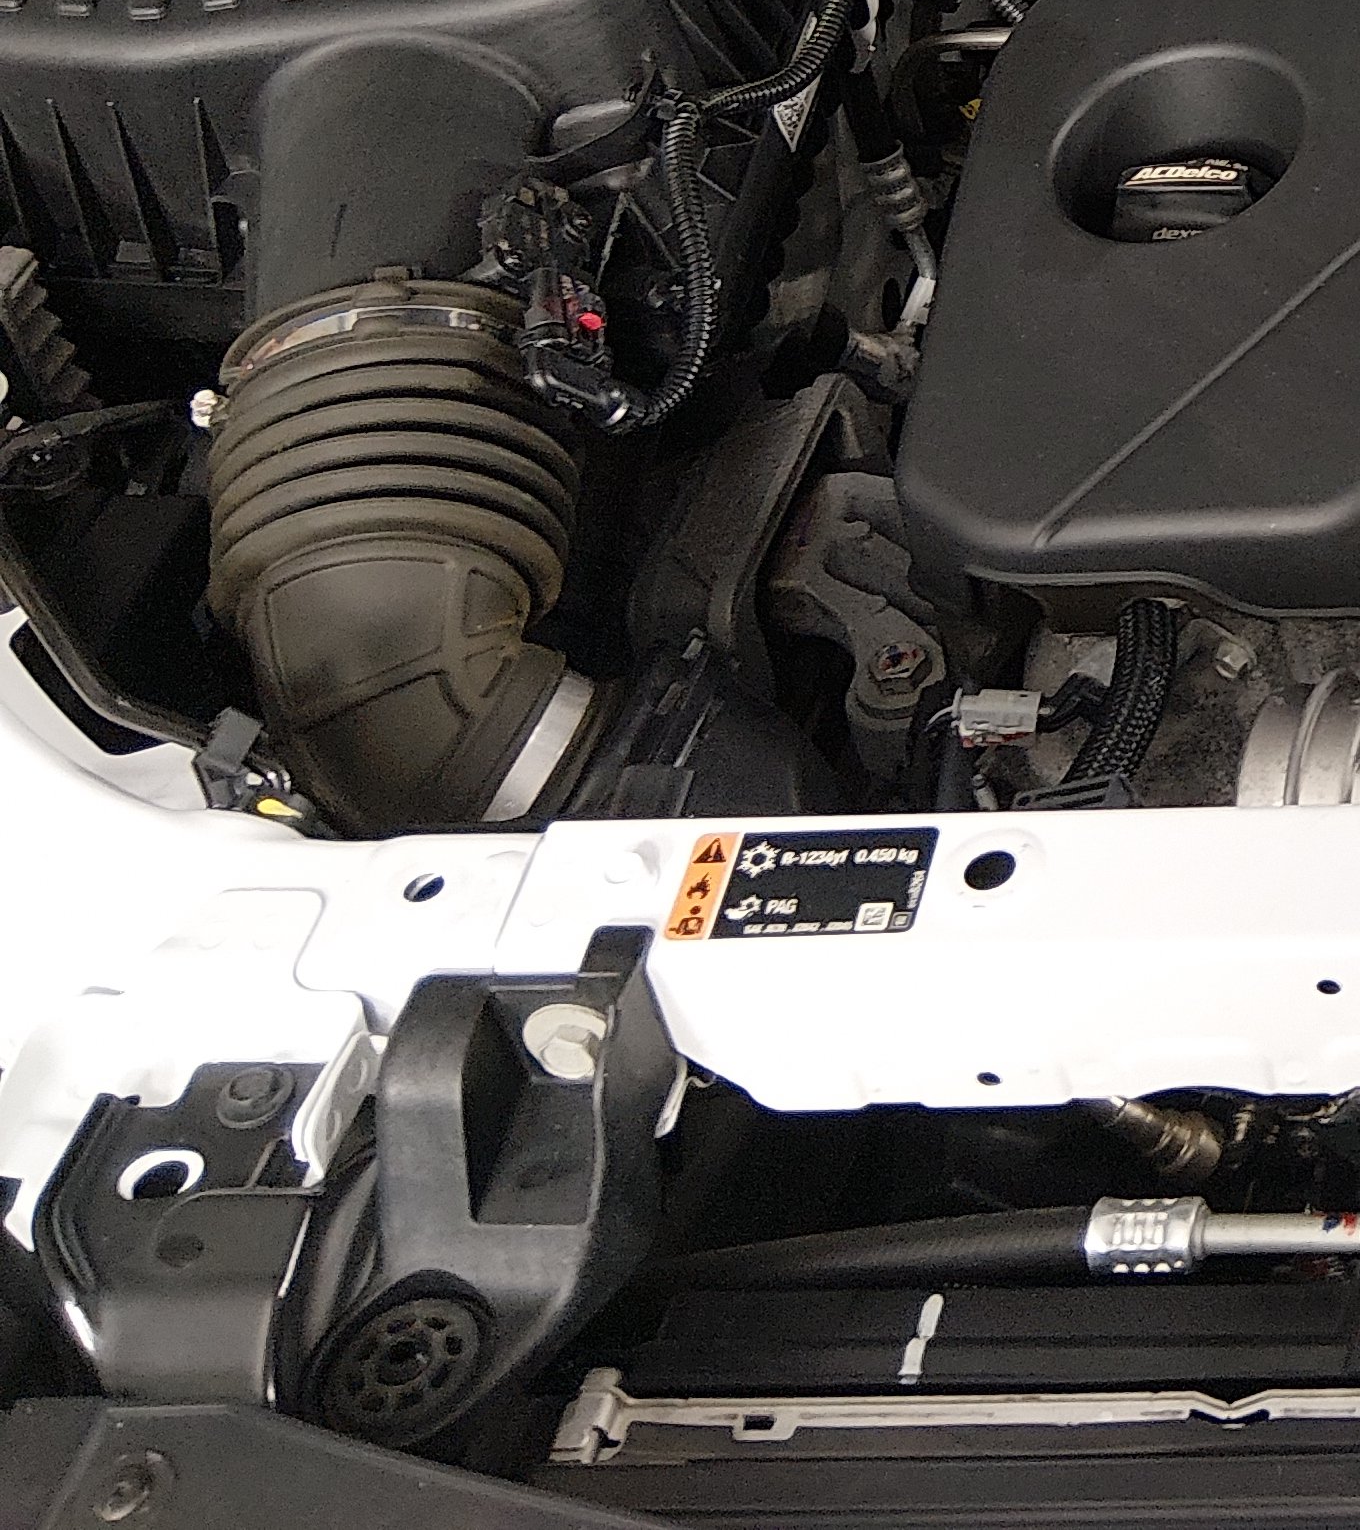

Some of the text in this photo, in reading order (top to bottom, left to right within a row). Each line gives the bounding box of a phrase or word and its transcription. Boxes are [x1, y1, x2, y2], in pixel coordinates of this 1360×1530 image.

[1131, 165, 1239, 181] ACDelco
[854, 848, 898, 865] 0.450
[897, 848, 919, 866] kg
[764, 898, 799, 915] PAG
